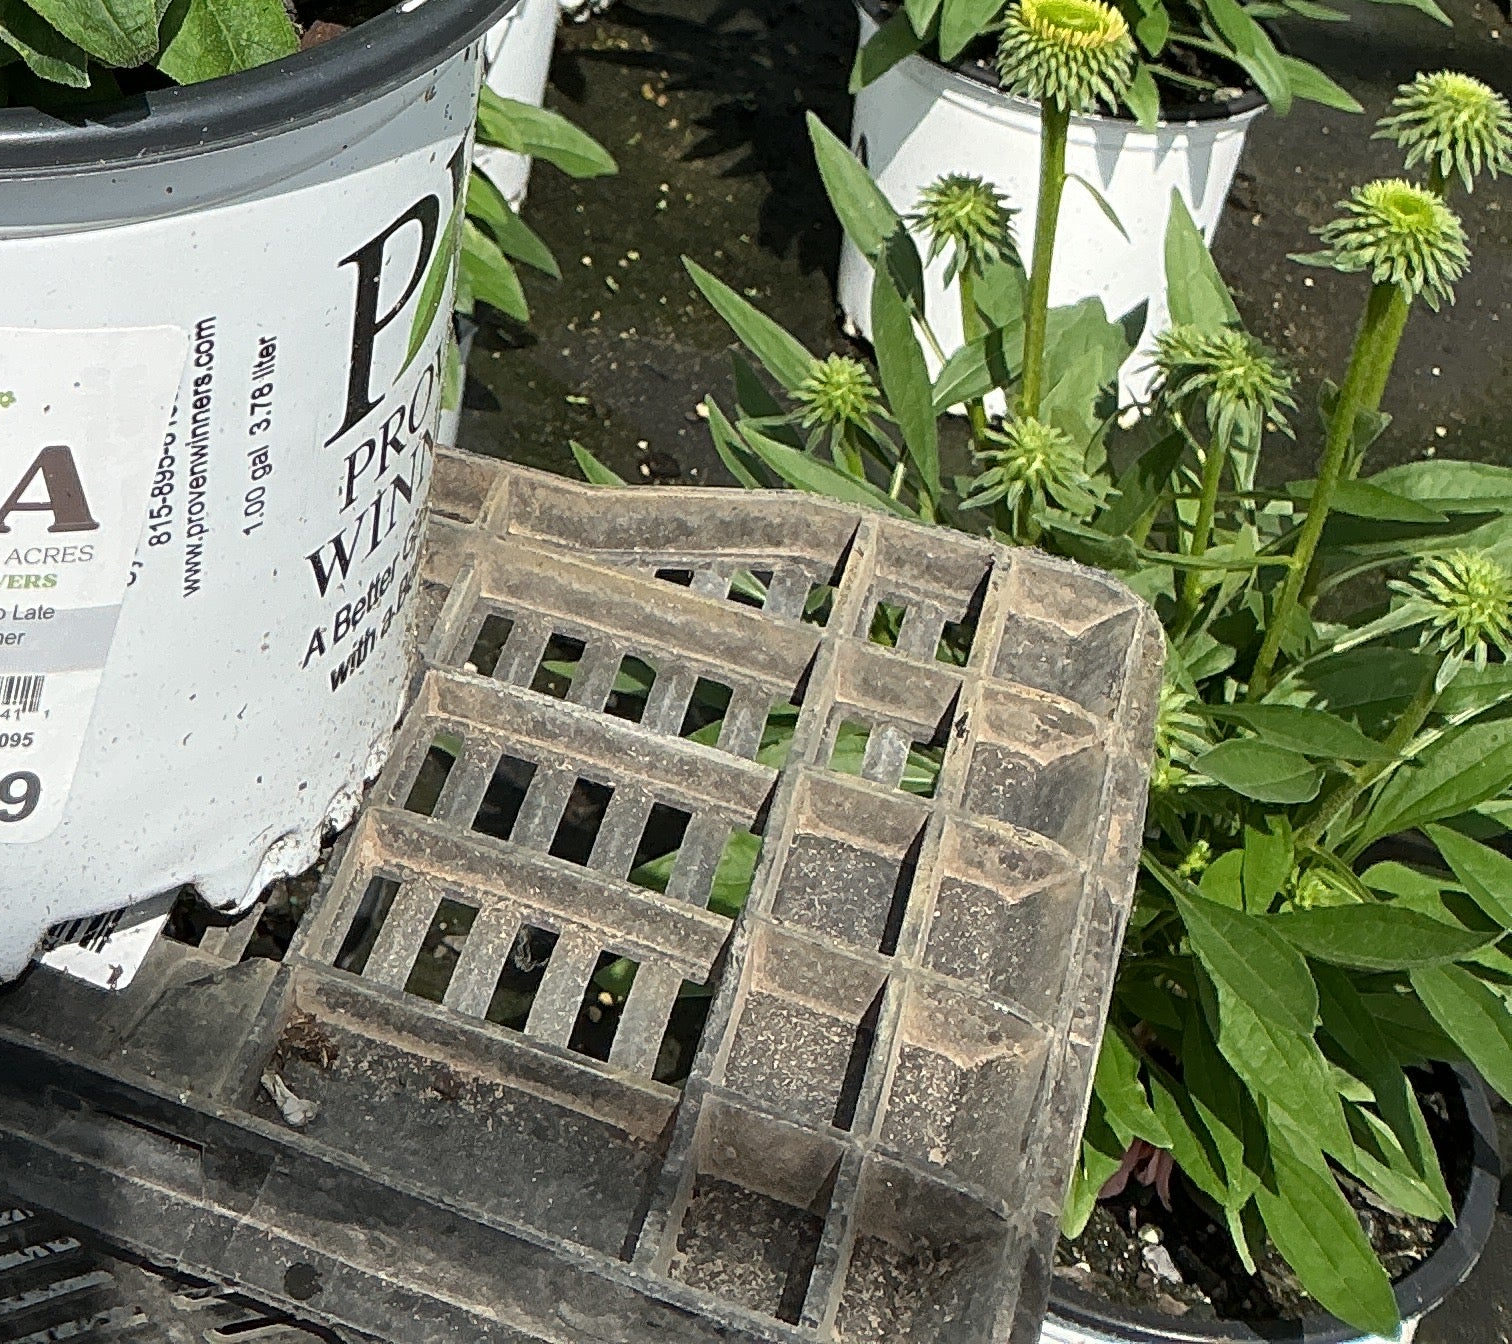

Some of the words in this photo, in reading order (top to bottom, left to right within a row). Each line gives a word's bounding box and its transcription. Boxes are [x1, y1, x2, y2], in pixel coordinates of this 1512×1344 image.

[252, 335, 277, 381] liter
[249, 382, 274, 436] 3.78
[183, 316, 217, 599] www.provenwinners.com
[247, 444, 273, 481] gal
[242, 486, 266, 537] 1.00
[4, 543, 94, 566] ACRES
[12, 603, 55, 622] Late
[302, 626, 326, 670] A
[332, 551, 400, 646] Better
[329, 627, 377, 693] with
